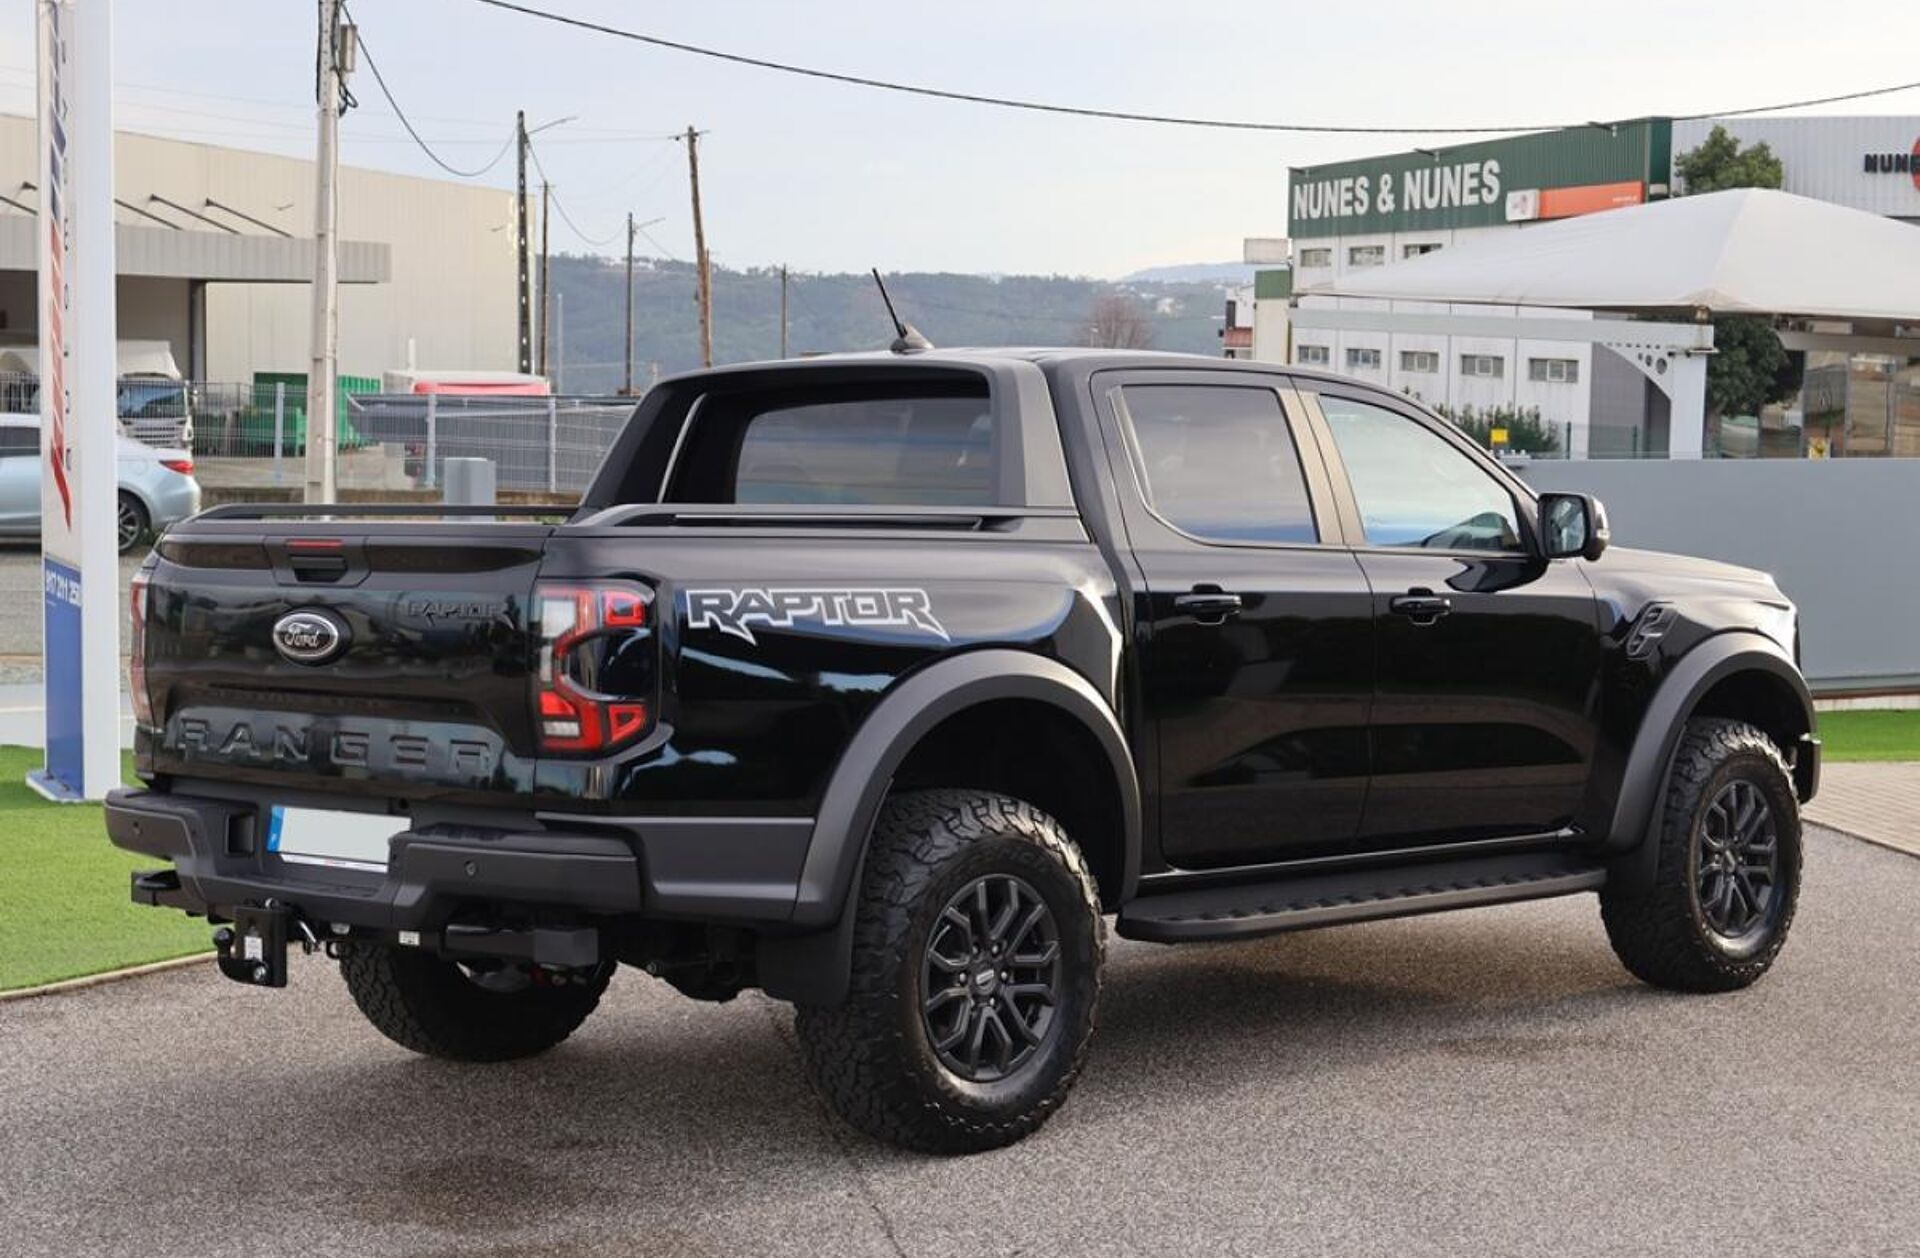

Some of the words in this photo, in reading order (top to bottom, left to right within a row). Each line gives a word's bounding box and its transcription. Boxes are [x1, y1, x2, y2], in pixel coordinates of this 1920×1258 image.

[1293, 176, 1369, 220] NUNES
[1377, 173, 1395, 213] &
[1403, 159, 1500, 211] NUNES
[284, 622, 320, 649] Ford
[686, 588, 951, 646] RAPTOR
[176, 718, 494, 779] RANGER
